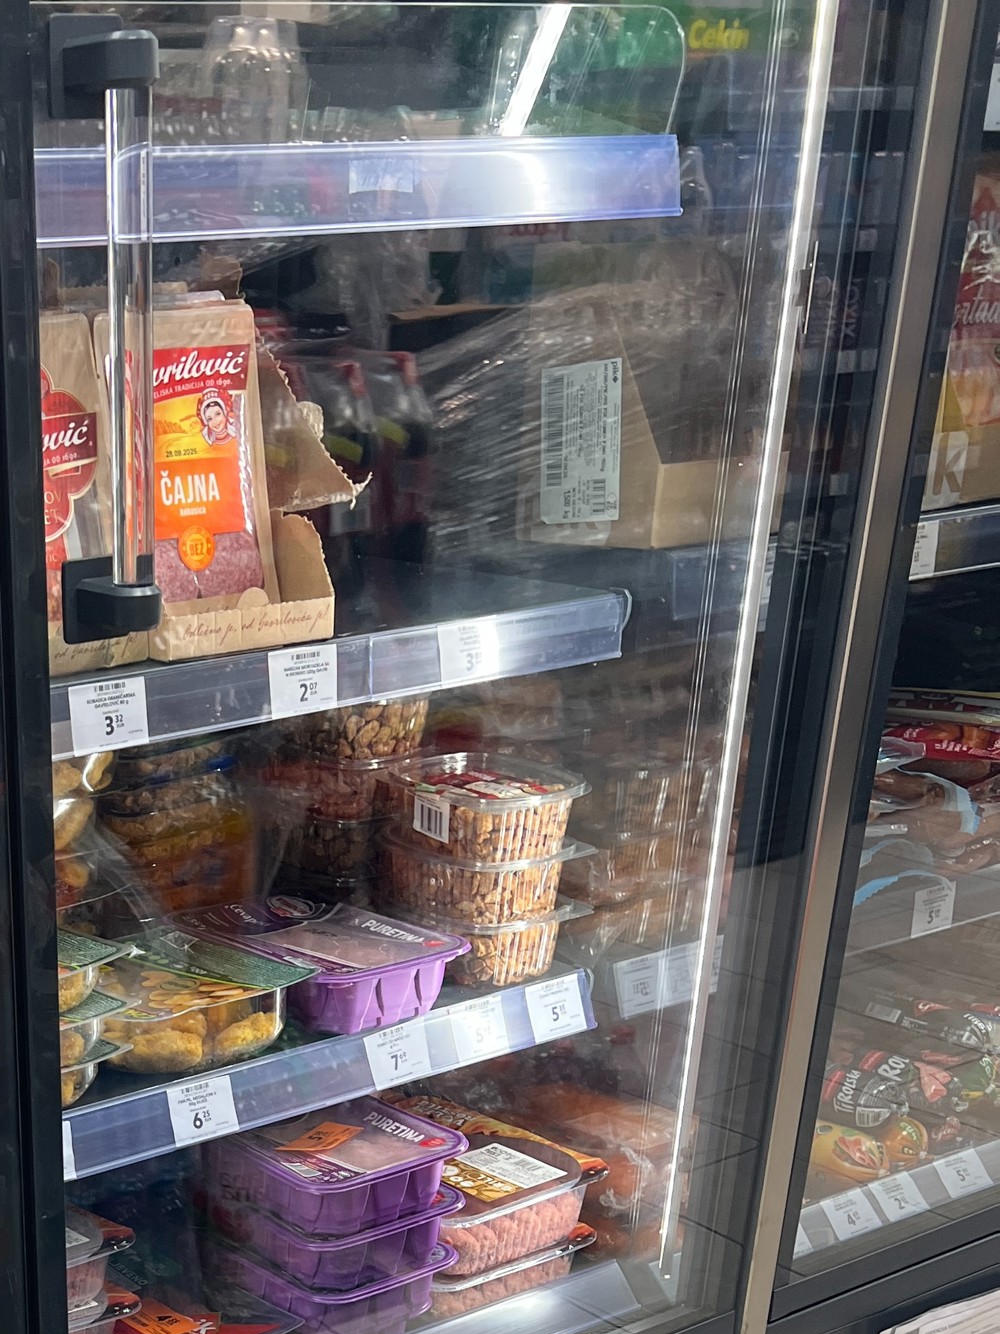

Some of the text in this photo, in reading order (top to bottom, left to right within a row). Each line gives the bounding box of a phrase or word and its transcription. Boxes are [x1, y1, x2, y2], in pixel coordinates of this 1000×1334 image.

[688, 18, 749, 49] Cekin
[153, 350, 246, 387] vrilović
[174, 383, 205, 393] TRADICIJA
[160, 471, 221, 507] ČAJNA
[189, 541, 205, 557] BEZ
[466, 652, 474, 672] 3
[299, 682, 318, 703] 2 07
[104, 714, 124, 736] 3 32
[360, 918, 425, 944] PURETINA
[551, 1005, 560, 1022] 5
[390, 1054, 398, 1072] 7
[192, 1109, 211, 1130] 6 25
[364, 1110, 426, 1143] PURETINA
[956, 1170, 966, 1183] 5
